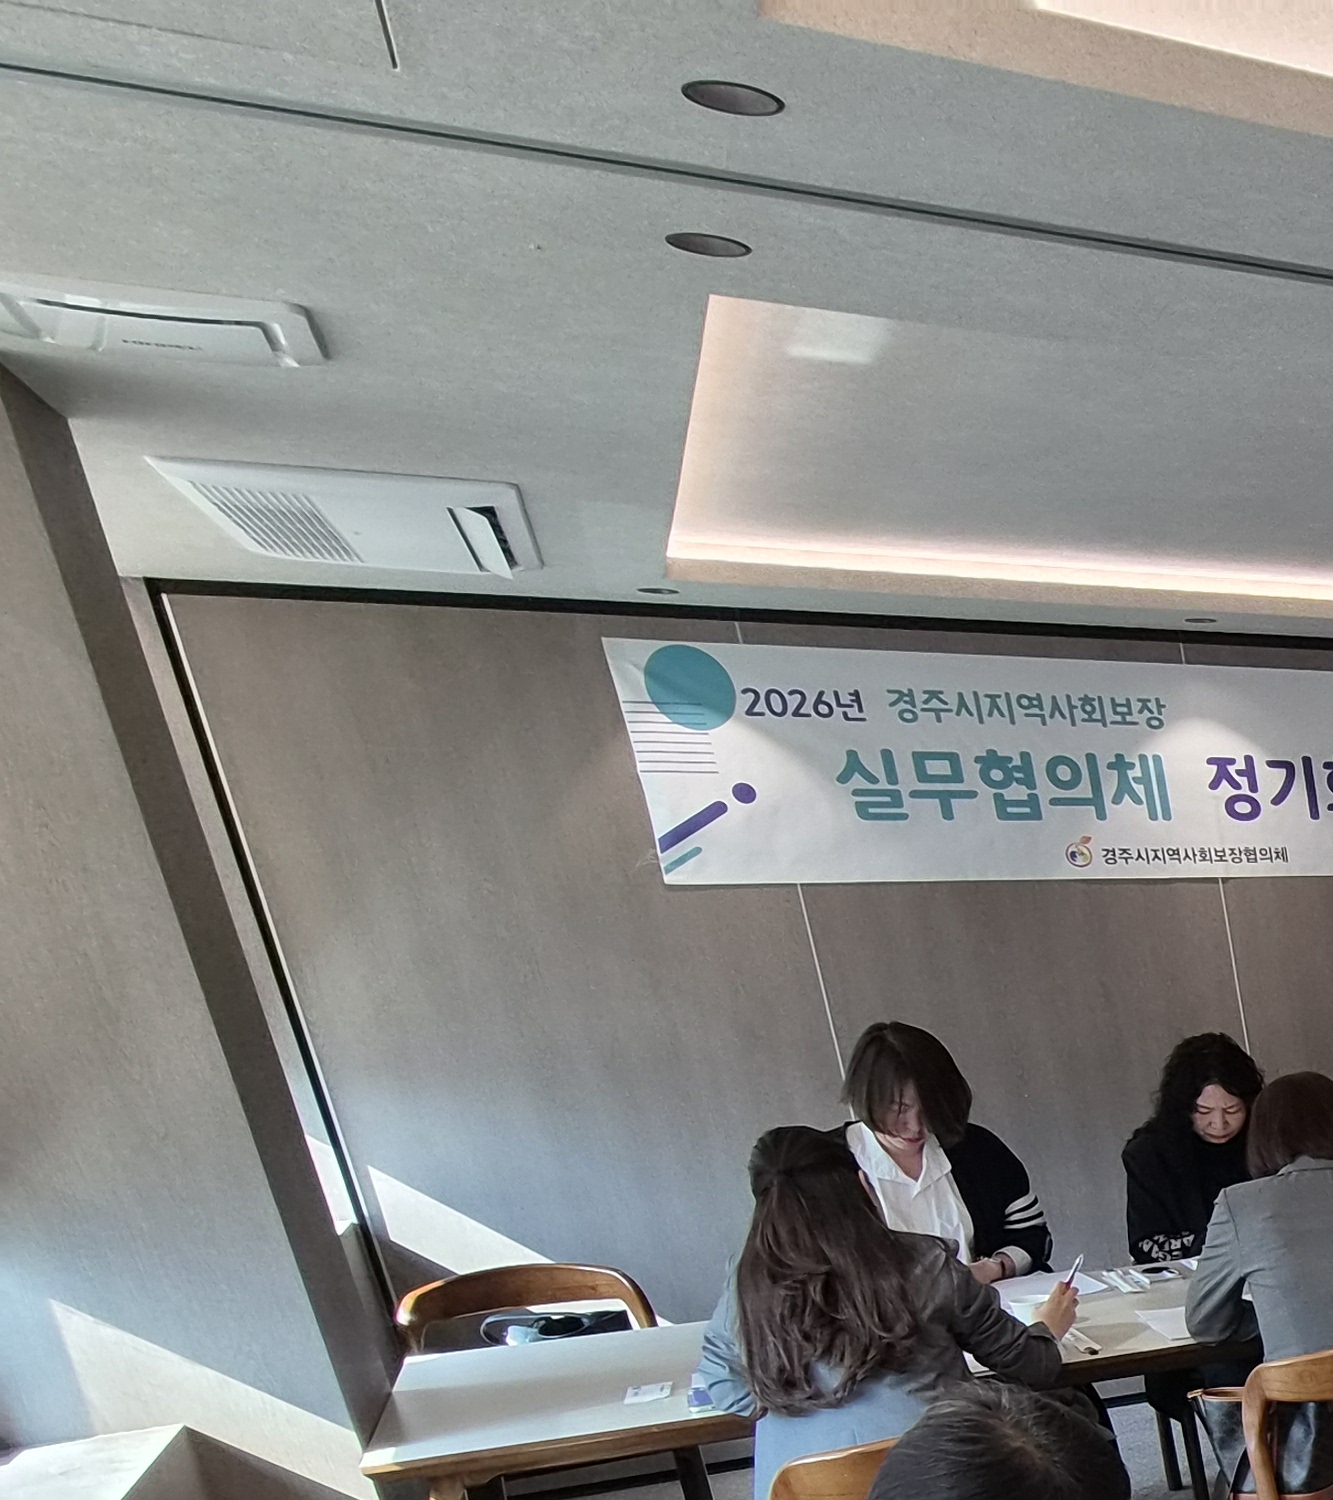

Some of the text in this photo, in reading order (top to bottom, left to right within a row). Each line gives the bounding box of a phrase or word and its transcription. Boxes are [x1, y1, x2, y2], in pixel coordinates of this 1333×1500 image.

[740, 686, 1167, 731] 2026년 경주시지역사회보장
[836, 748, 1172, 822] 실무협의체
[1101, 846, 1289, 865] 경주시지역사회보장협의체
